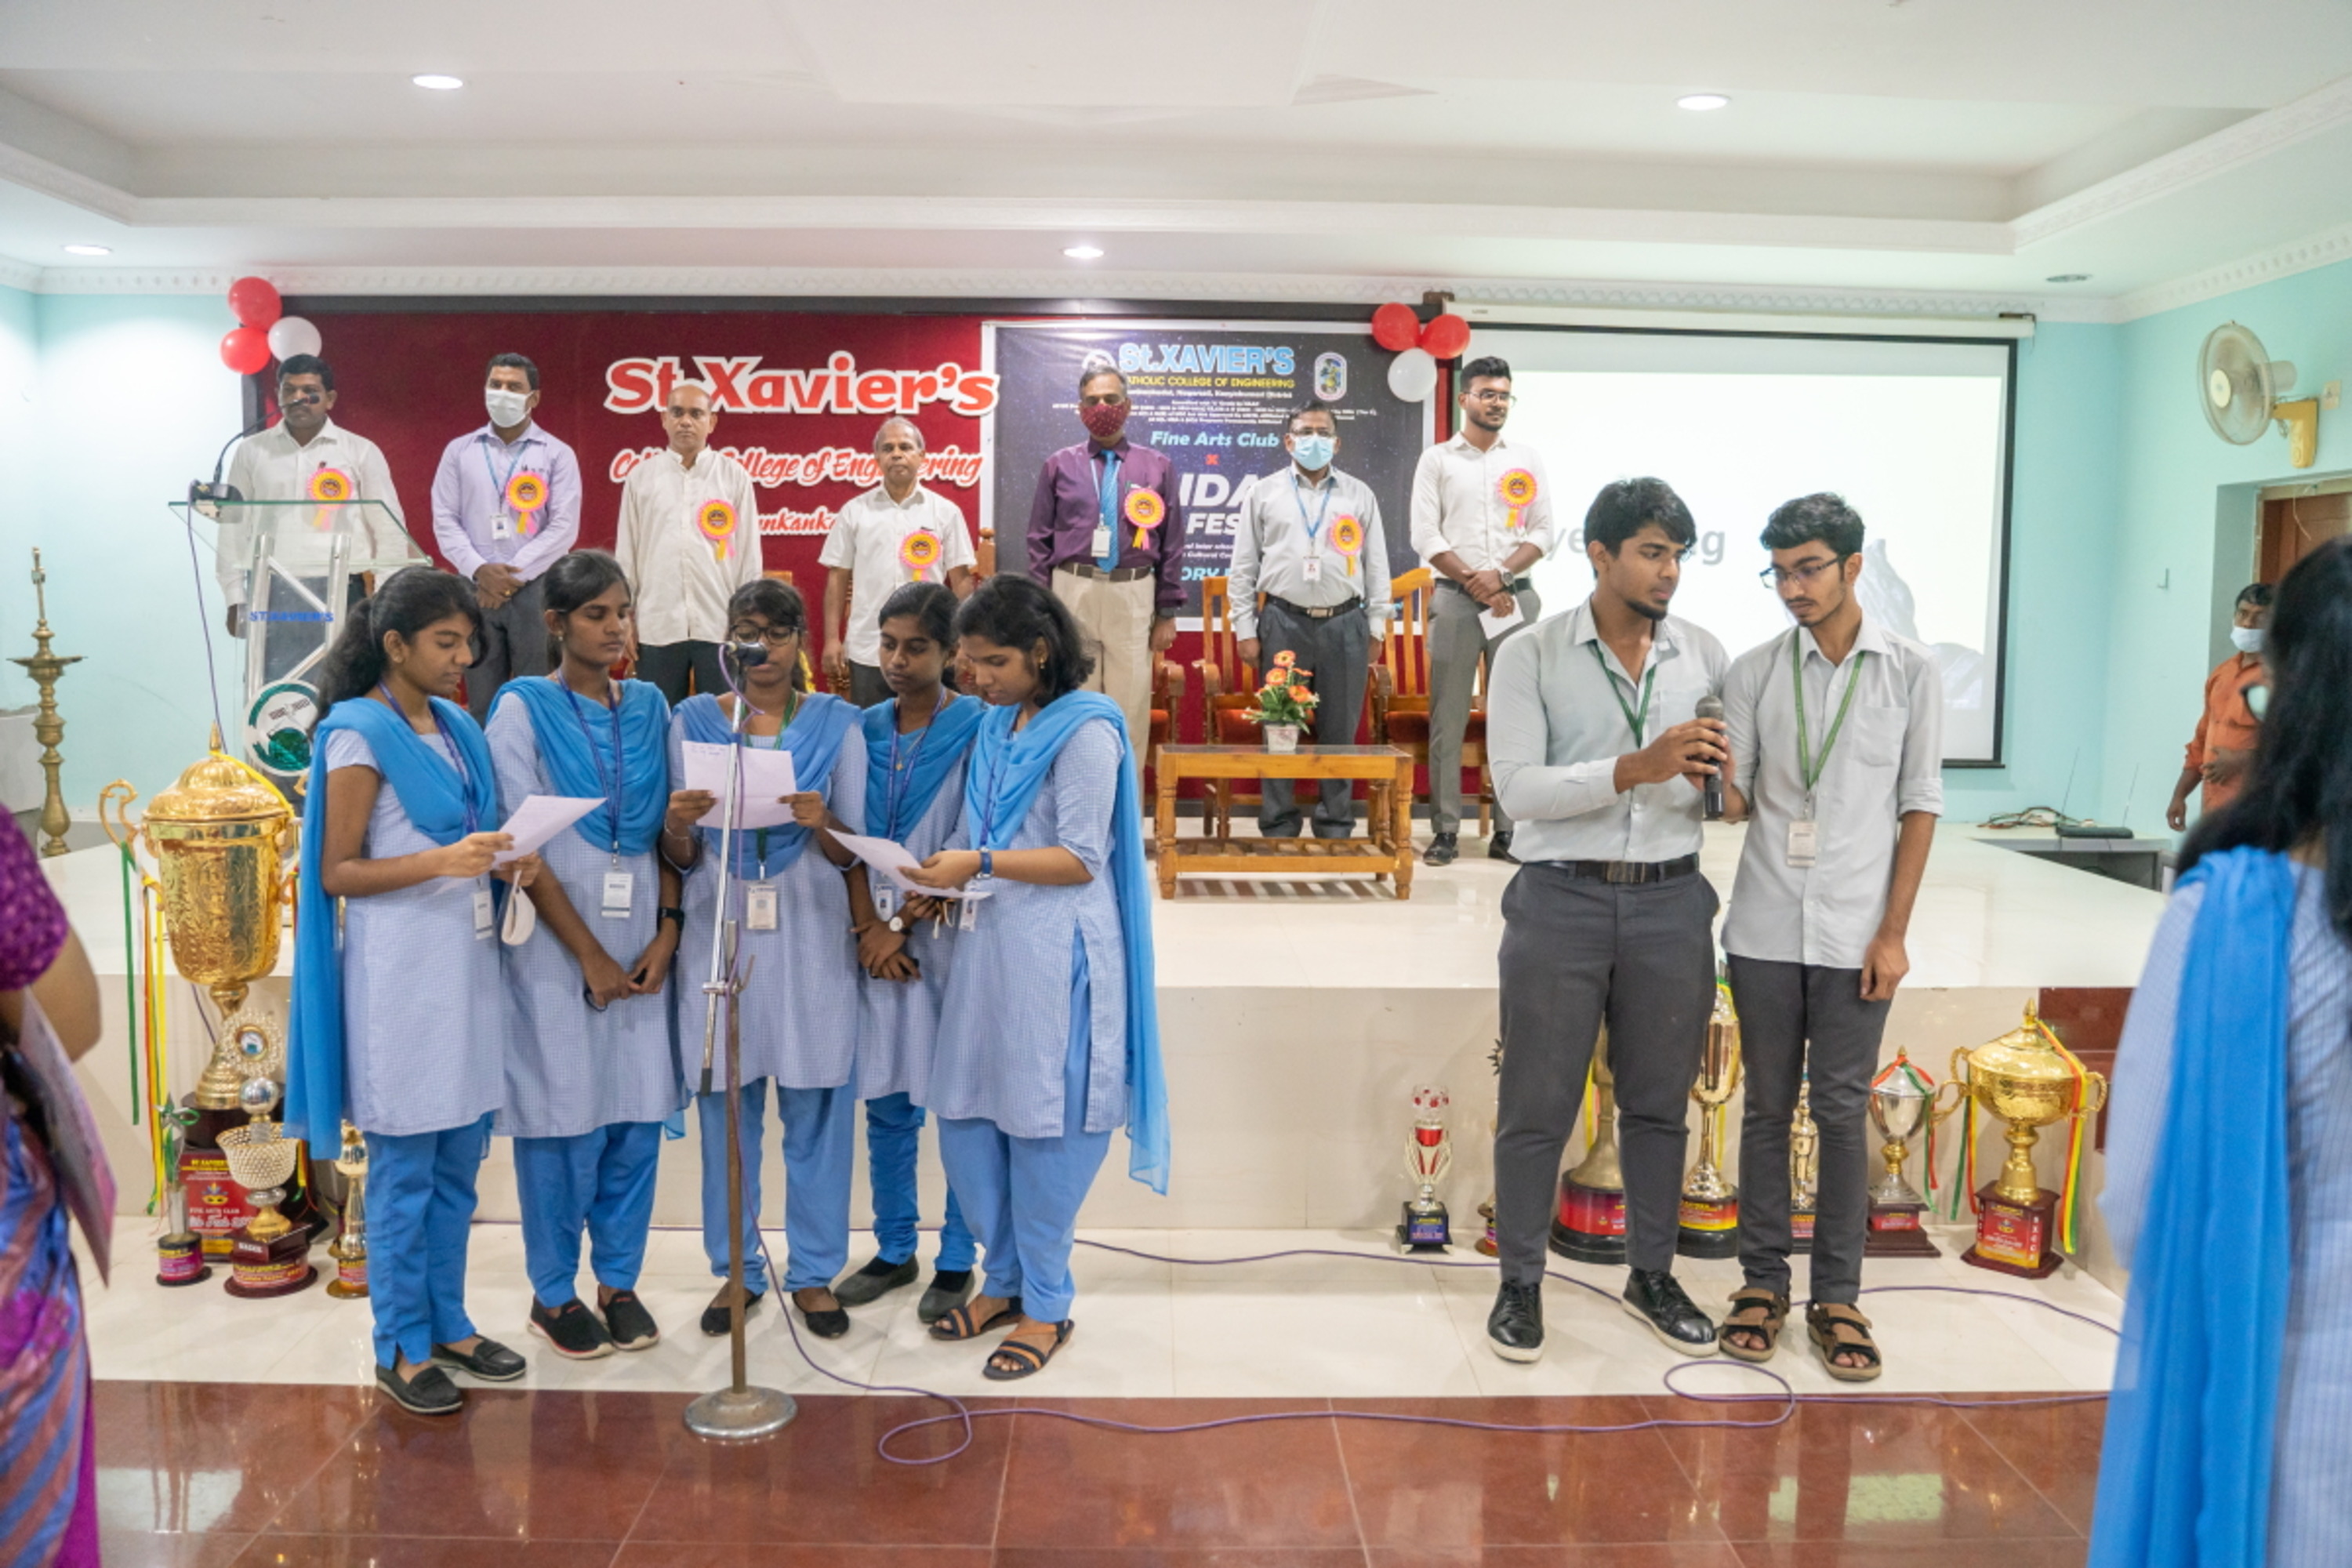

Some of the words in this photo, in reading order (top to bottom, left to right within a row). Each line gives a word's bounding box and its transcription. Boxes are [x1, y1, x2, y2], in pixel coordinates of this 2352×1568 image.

[1127, 376, 1165, 387] ATHOLIC
[1167, 376, 1212, 387] COLLEGE
[1214, 377, 1228, 387] OF
[1230, 377, 1296, 389] ENGINEERING
[1150, 431, 1190, 446] Fine
[1194, 432, 1232, 446] Arts
[1237, 433, 1279, 448] Club
[1185, 513, 1240, 535] FES
